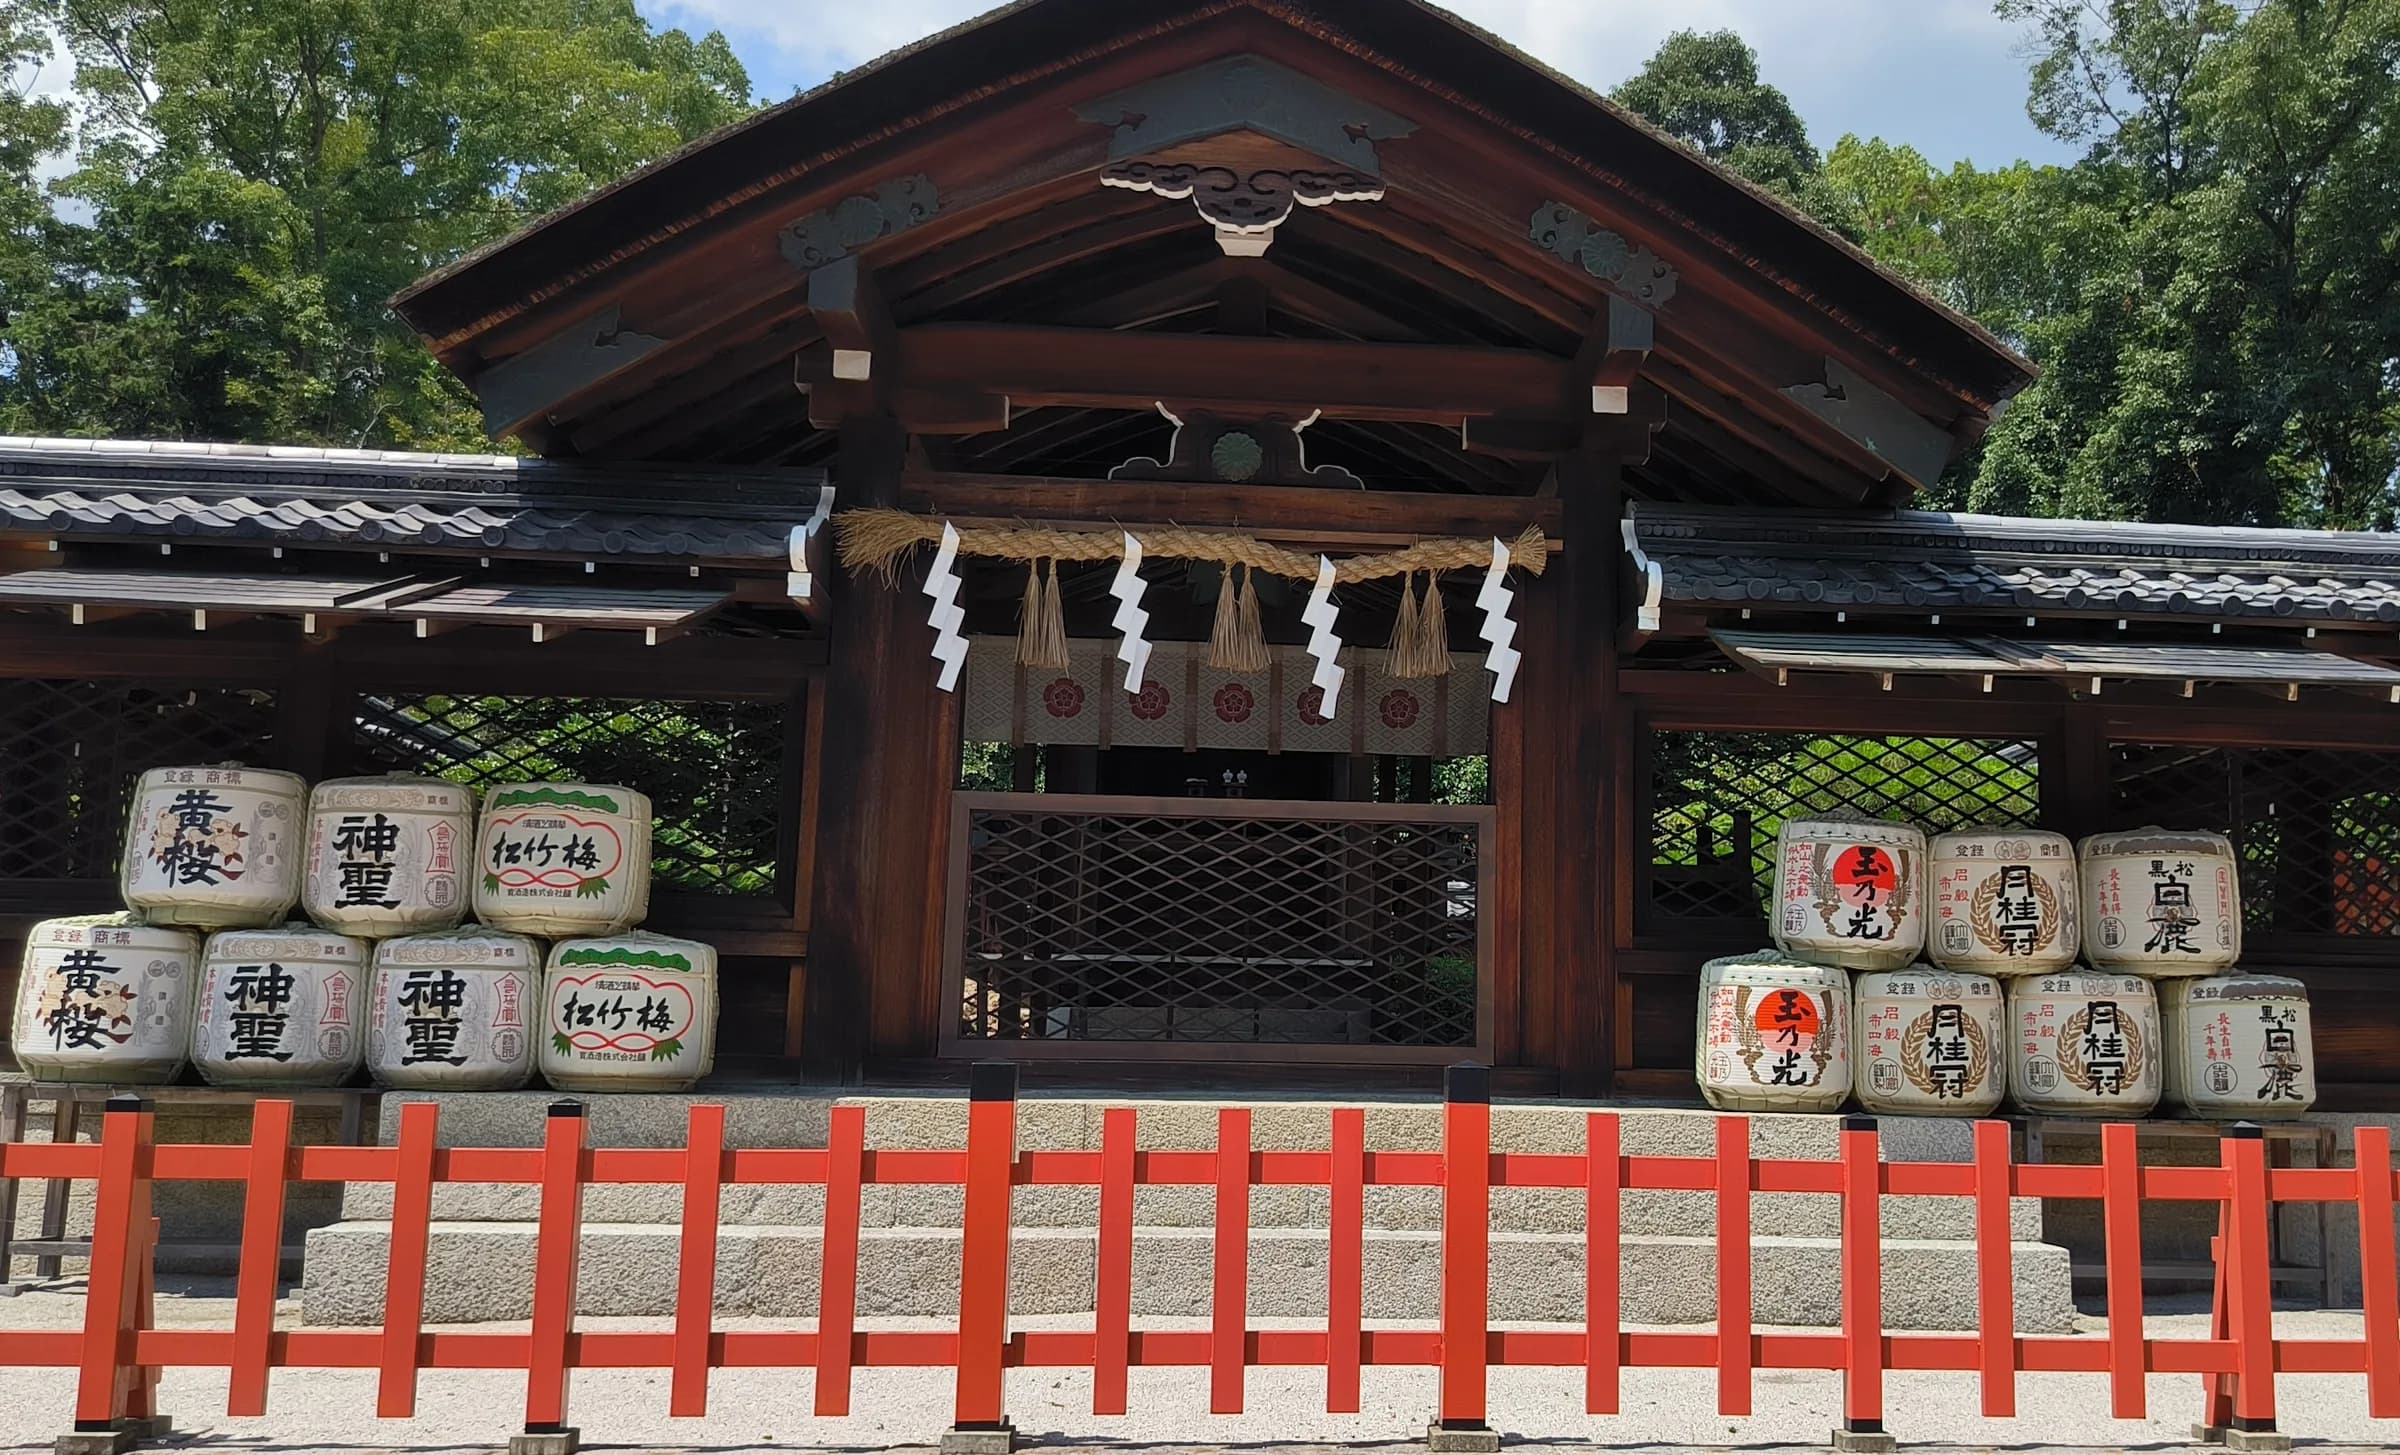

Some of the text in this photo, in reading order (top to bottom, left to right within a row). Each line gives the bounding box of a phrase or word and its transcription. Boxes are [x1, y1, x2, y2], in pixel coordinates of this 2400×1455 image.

[206, 771, 242, 784] 商標
[332, 813, 402, 910] 神聖
[492, 831, 602, 871] 松竹梅
[1847, 846, 1889, 940] 玉乃光
[94, 930, 131, 945] 商標
[1995, 865, 2040, 957] 月桂冠
[2144, 874, 2201, 954] 白鹿
[224, 963, 296, 1062] 神聖
[397, 970, 469, 1067] 神聖
[562, 991, 675, 1034] 松竹梅
[1771, 991, 1812, 1086] 玉乃光
[1926, 1004, 1969, 1100] 月桂冠
[2083, 1001, 2126, 1097] 月桂冠
[2257, 1019, 2304, 1101] 白鹿
